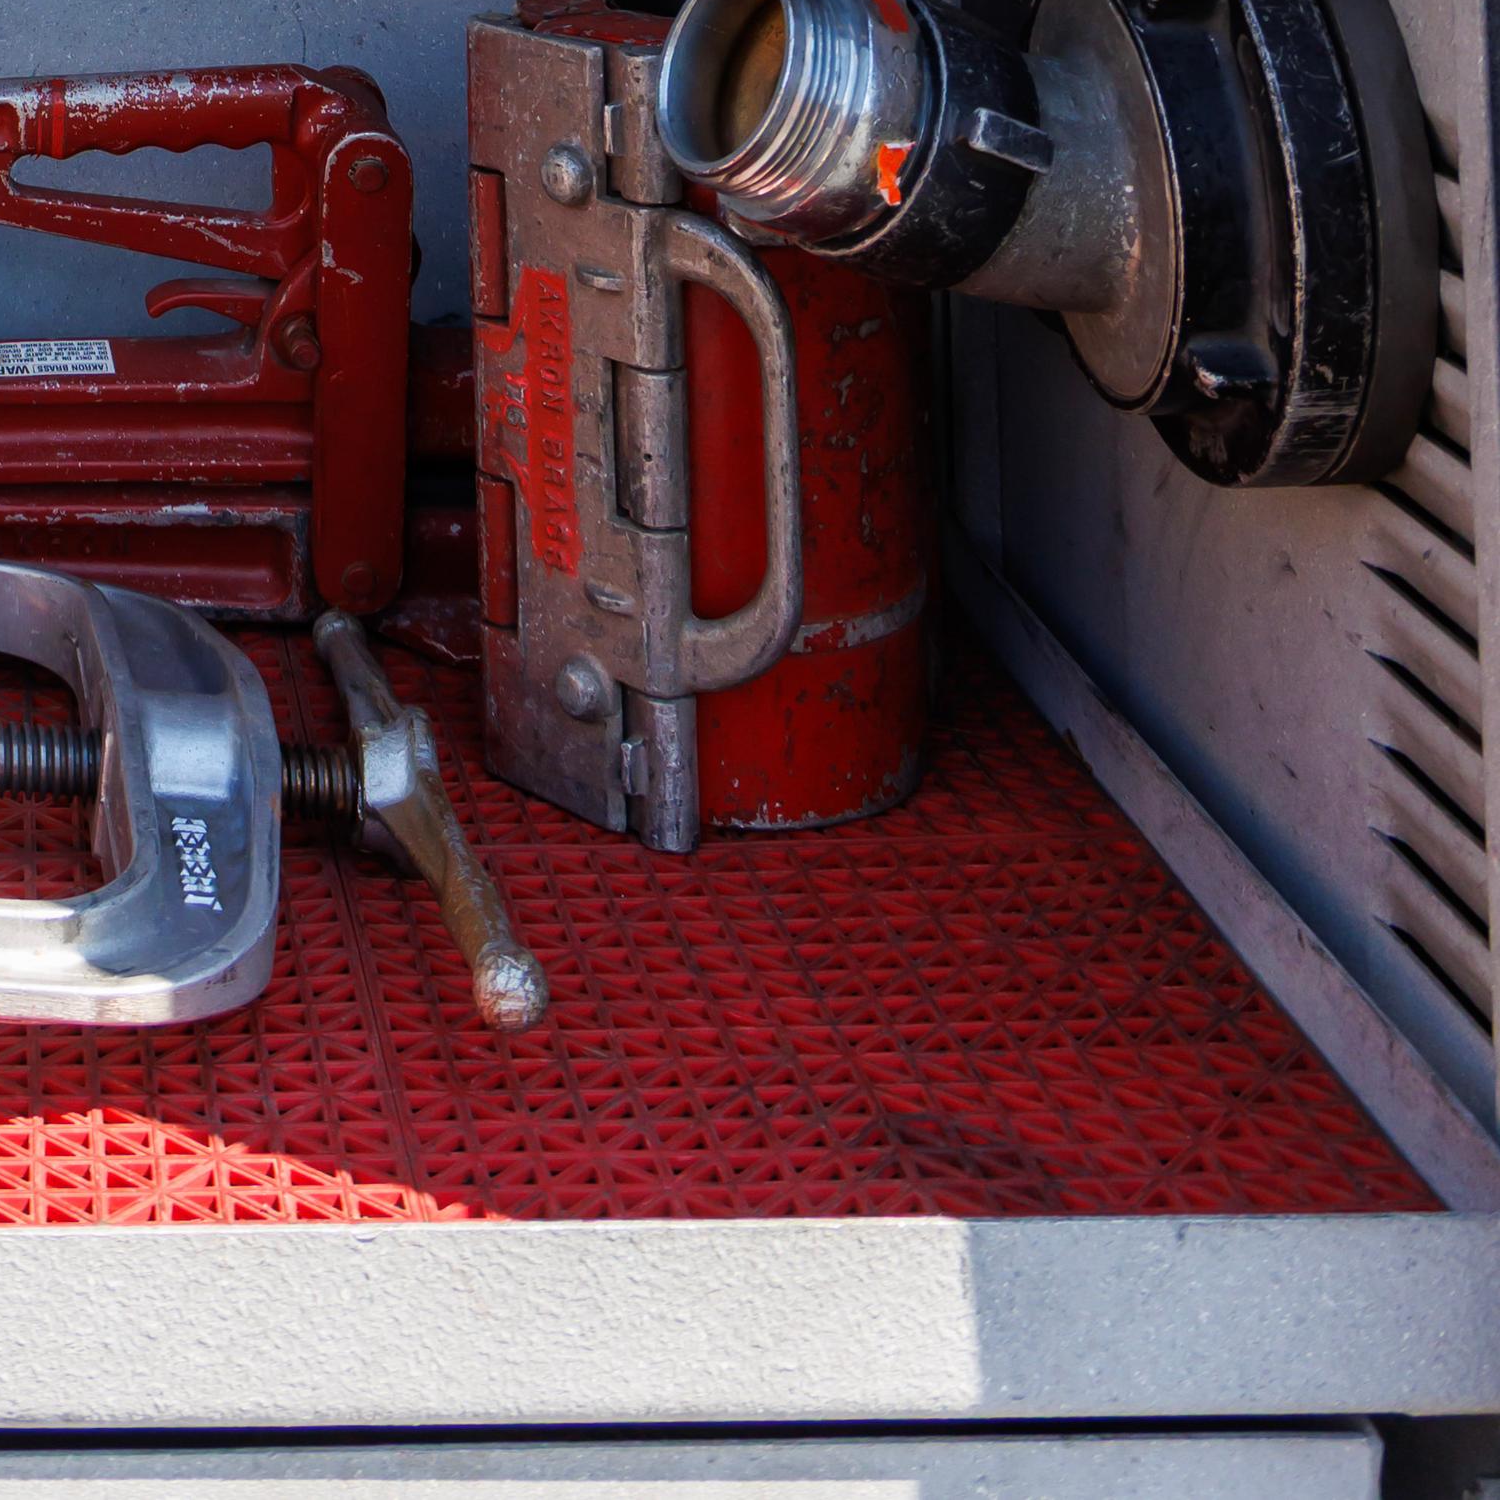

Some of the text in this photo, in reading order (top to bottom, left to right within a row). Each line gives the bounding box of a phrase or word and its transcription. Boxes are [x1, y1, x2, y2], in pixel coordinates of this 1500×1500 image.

[37, 364, 104, 373] AKRON BRASS
[538, 280, 571, 574] AKRON BRASS
